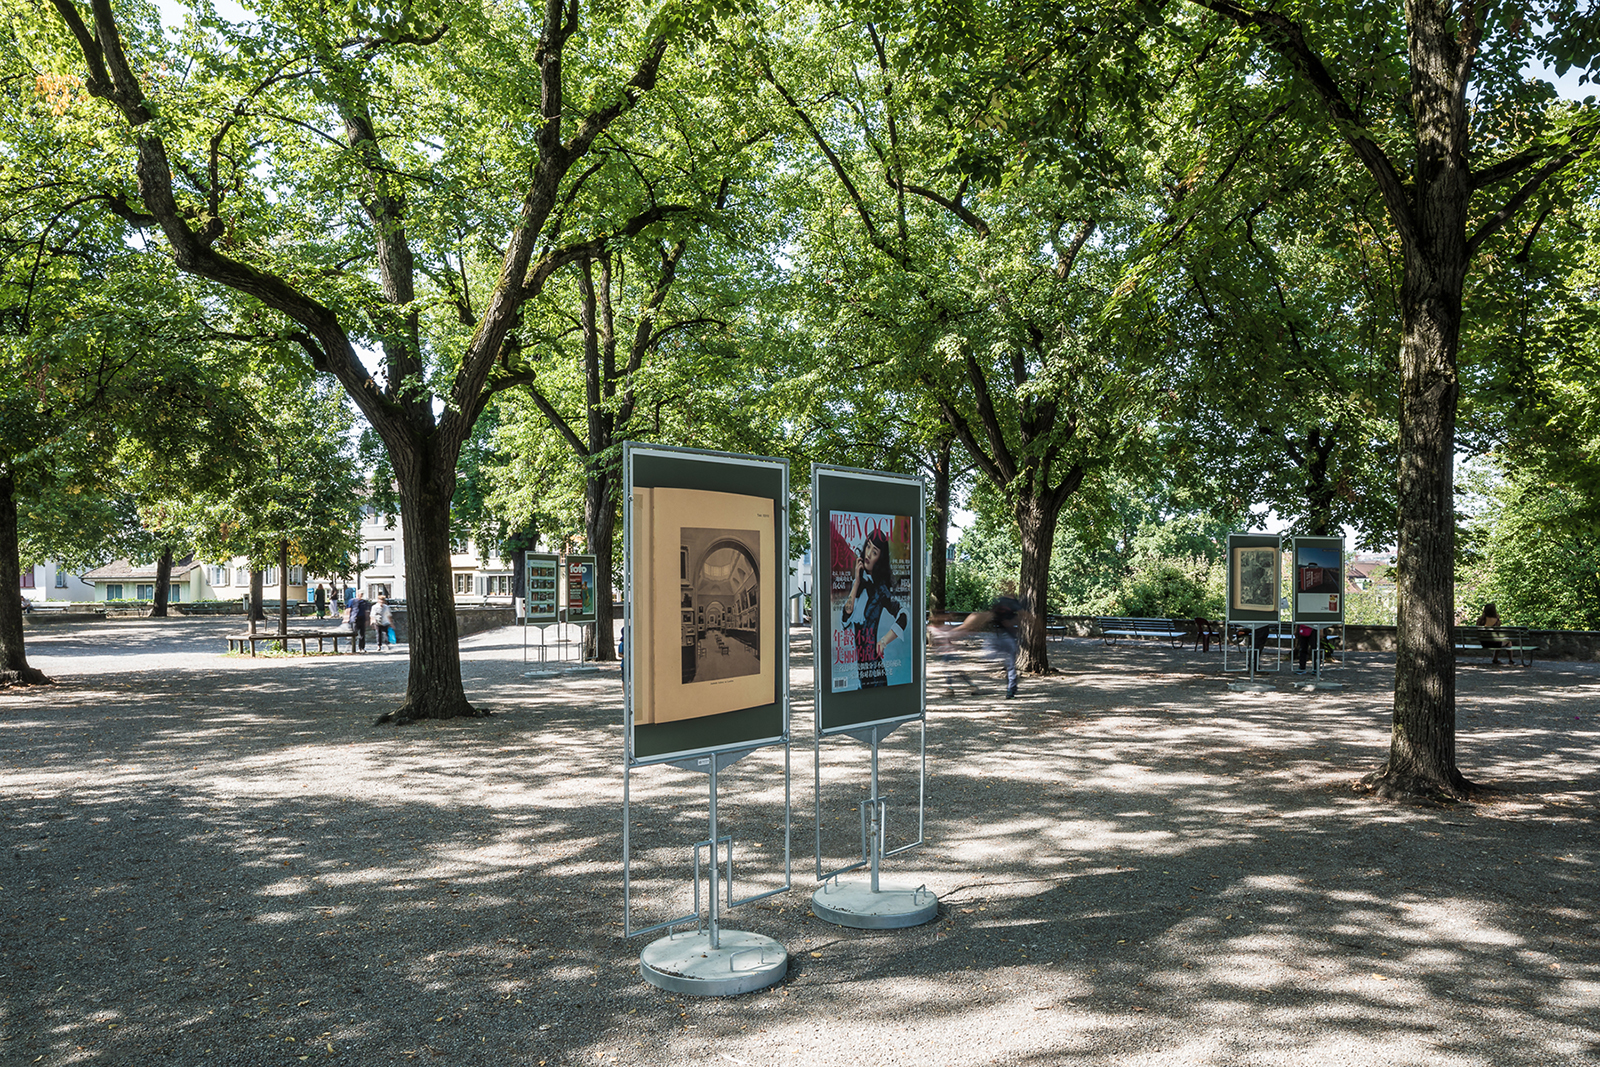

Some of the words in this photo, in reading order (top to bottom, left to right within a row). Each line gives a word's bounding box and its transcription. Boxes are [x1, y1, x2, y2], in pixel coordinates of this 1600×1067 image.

[831, 513, 855, 541] 服饰
[854, 515, 910, 543] VOGUE
[832, 542, 856, 569] 美容
[570, 563, 587, 573] foto
[833, 628, 875, 647] 年龄不是
[833, 644, 885, 665] 美丽的敌人
